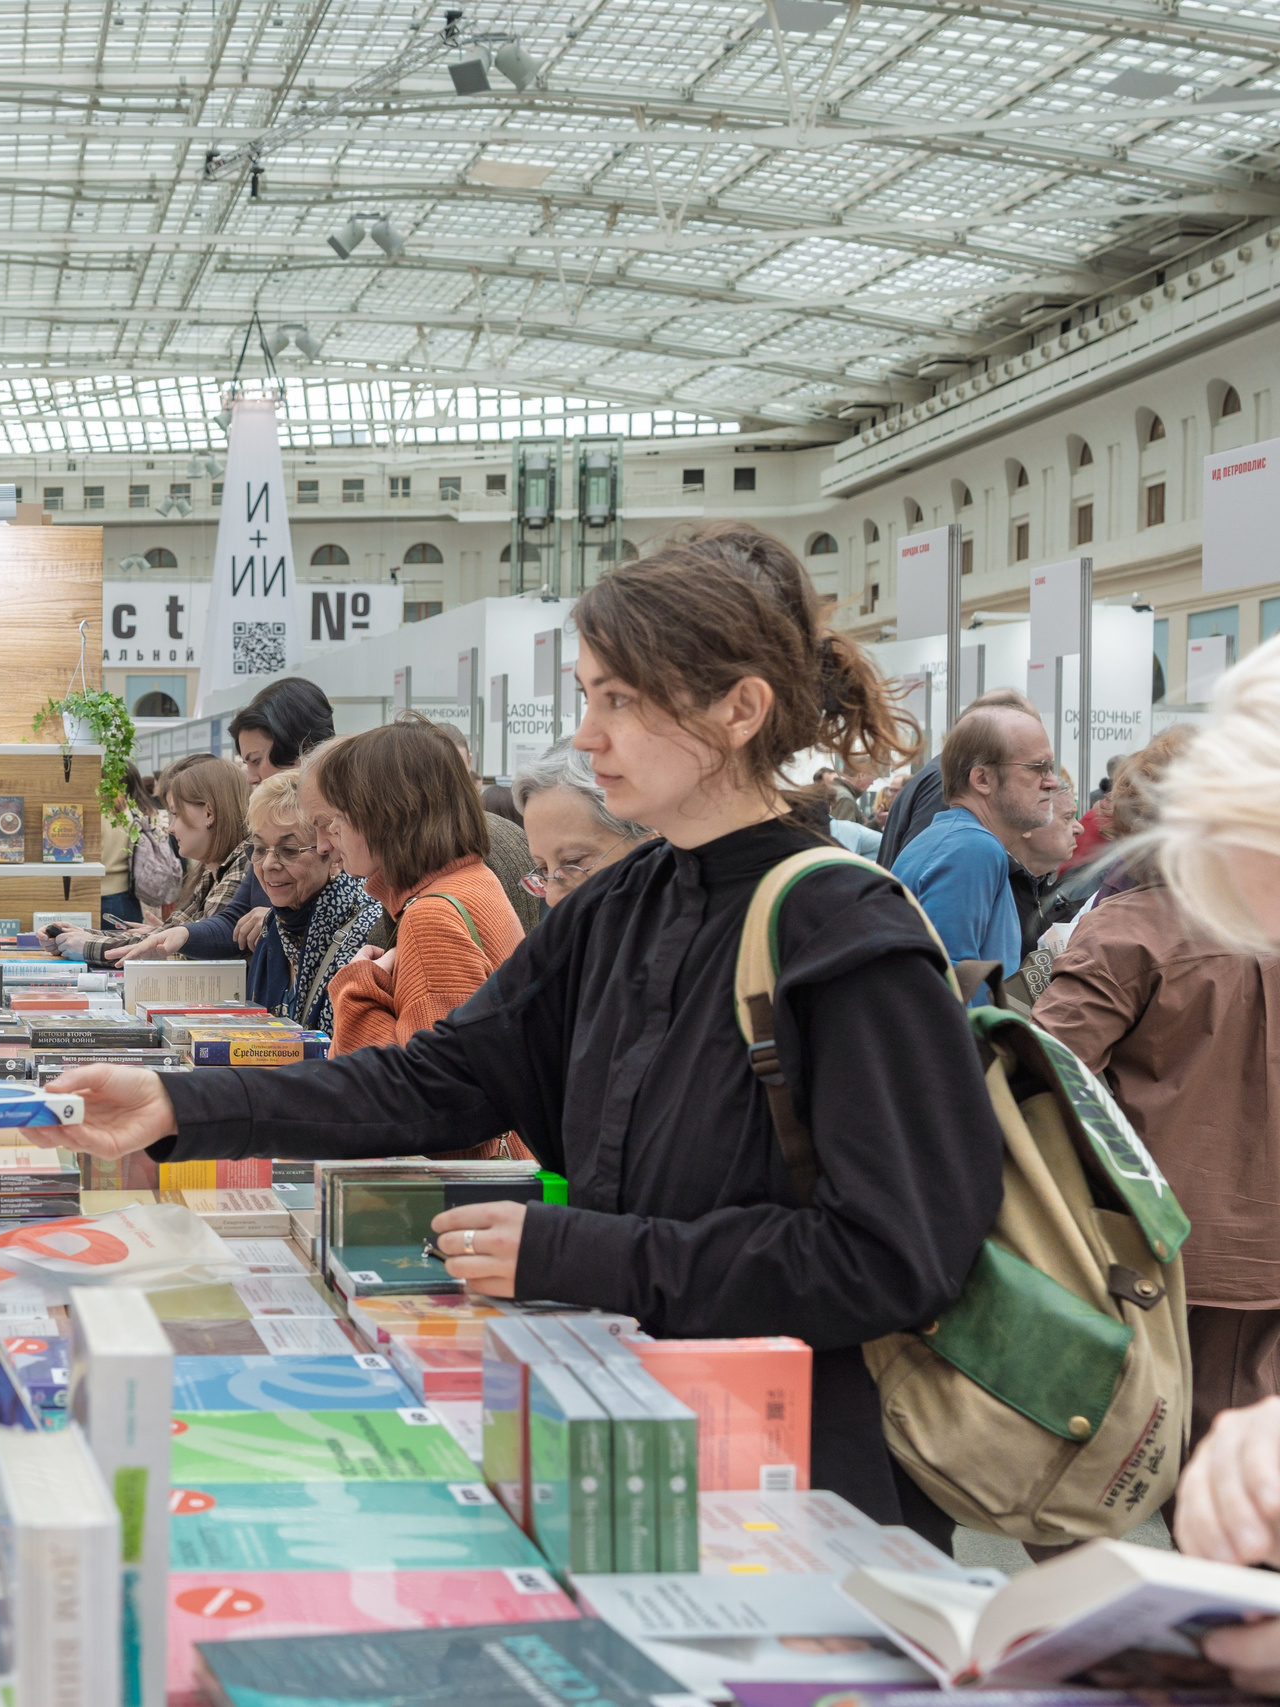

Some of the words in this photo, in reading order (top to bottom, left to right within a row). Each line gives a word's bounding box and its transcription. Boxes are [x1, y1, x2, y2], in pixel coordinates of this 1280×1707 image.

[1211, 468, 1222, 481] ИД
[1223, 457, 1267, 478] ПЕТРОПОЛИС
[247, 481, 269, 523] И
[232, 555, 286, 597] ИИ
[1065, 709, 1142, 724] СКЗОЧНЫЕ
[1073, 727, 1133, 740] ИТОРИИ
[233, 1047, 300, 1059] Средневековью
